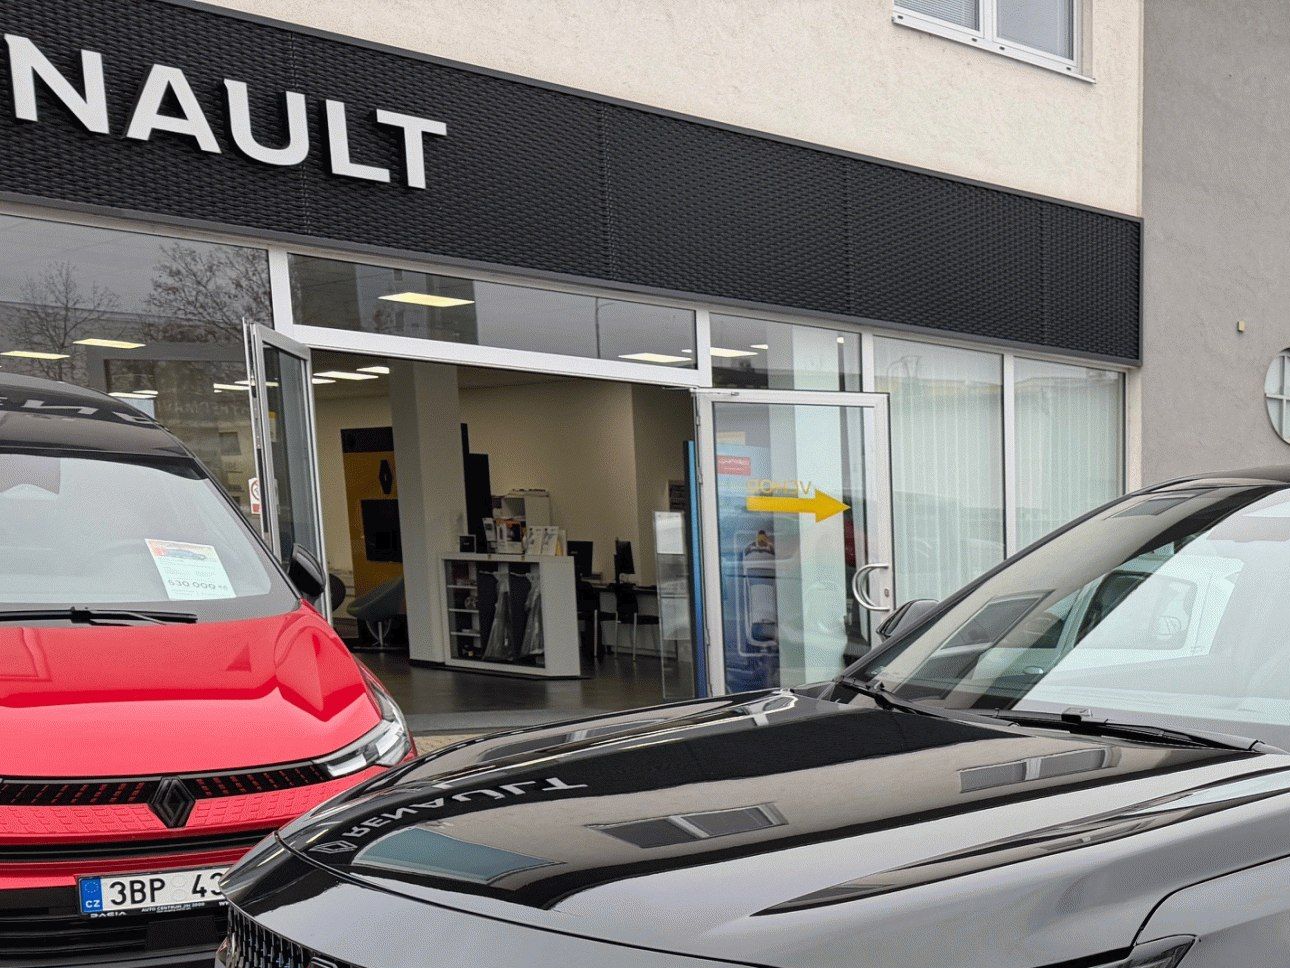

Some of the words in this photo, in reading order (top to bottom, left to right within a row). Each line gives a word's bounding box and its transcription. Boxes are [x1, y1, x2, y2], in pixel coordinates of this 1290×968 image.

[4, 33, 447, 190] NAULT
[85, 899, 100, 908] CZ
[109, 877, 166, 906] 3BP
